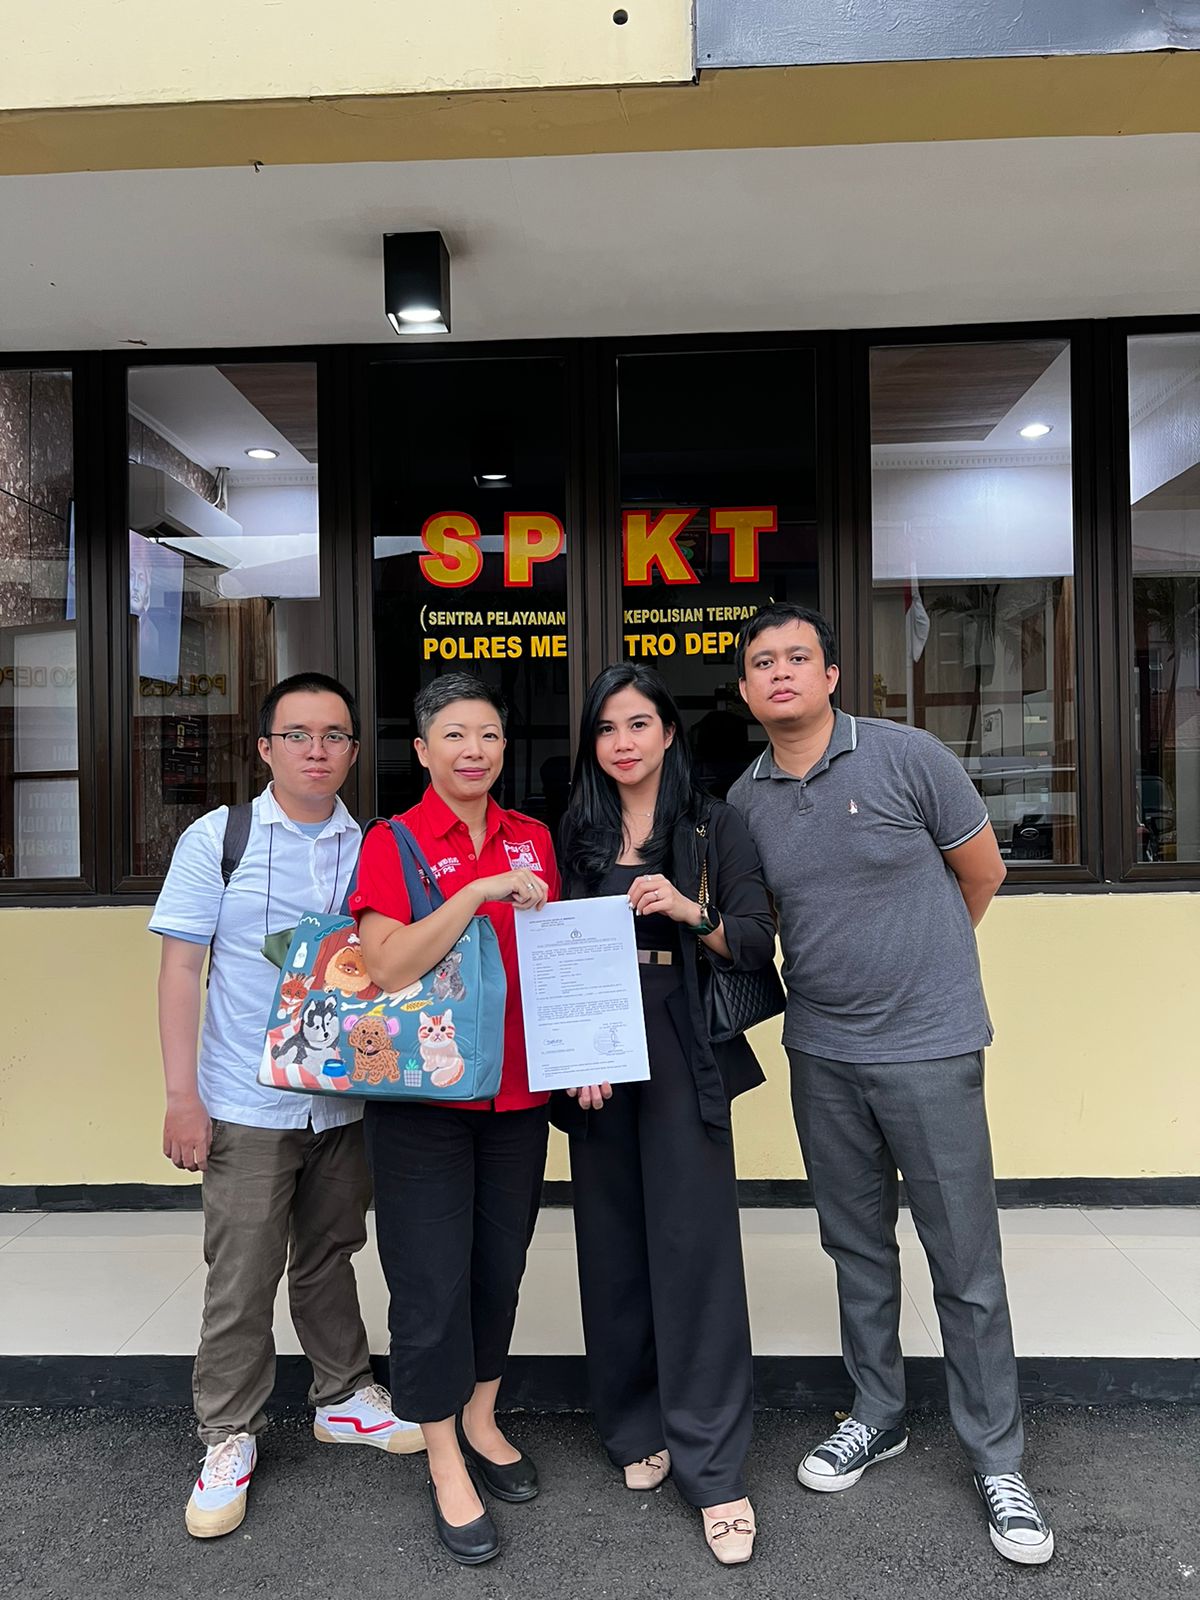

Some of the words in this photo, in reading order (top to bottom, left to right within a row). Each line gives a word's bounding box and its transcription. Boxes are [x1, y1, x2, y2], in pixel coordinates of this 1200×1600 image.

[487, 611, 566, 625] PELAYANAN
[624, 608, 703, 623] KEPOLISIAN
[706, 605, 760, 621] TERPAD
[423, 636, 522, 660] POLRES
